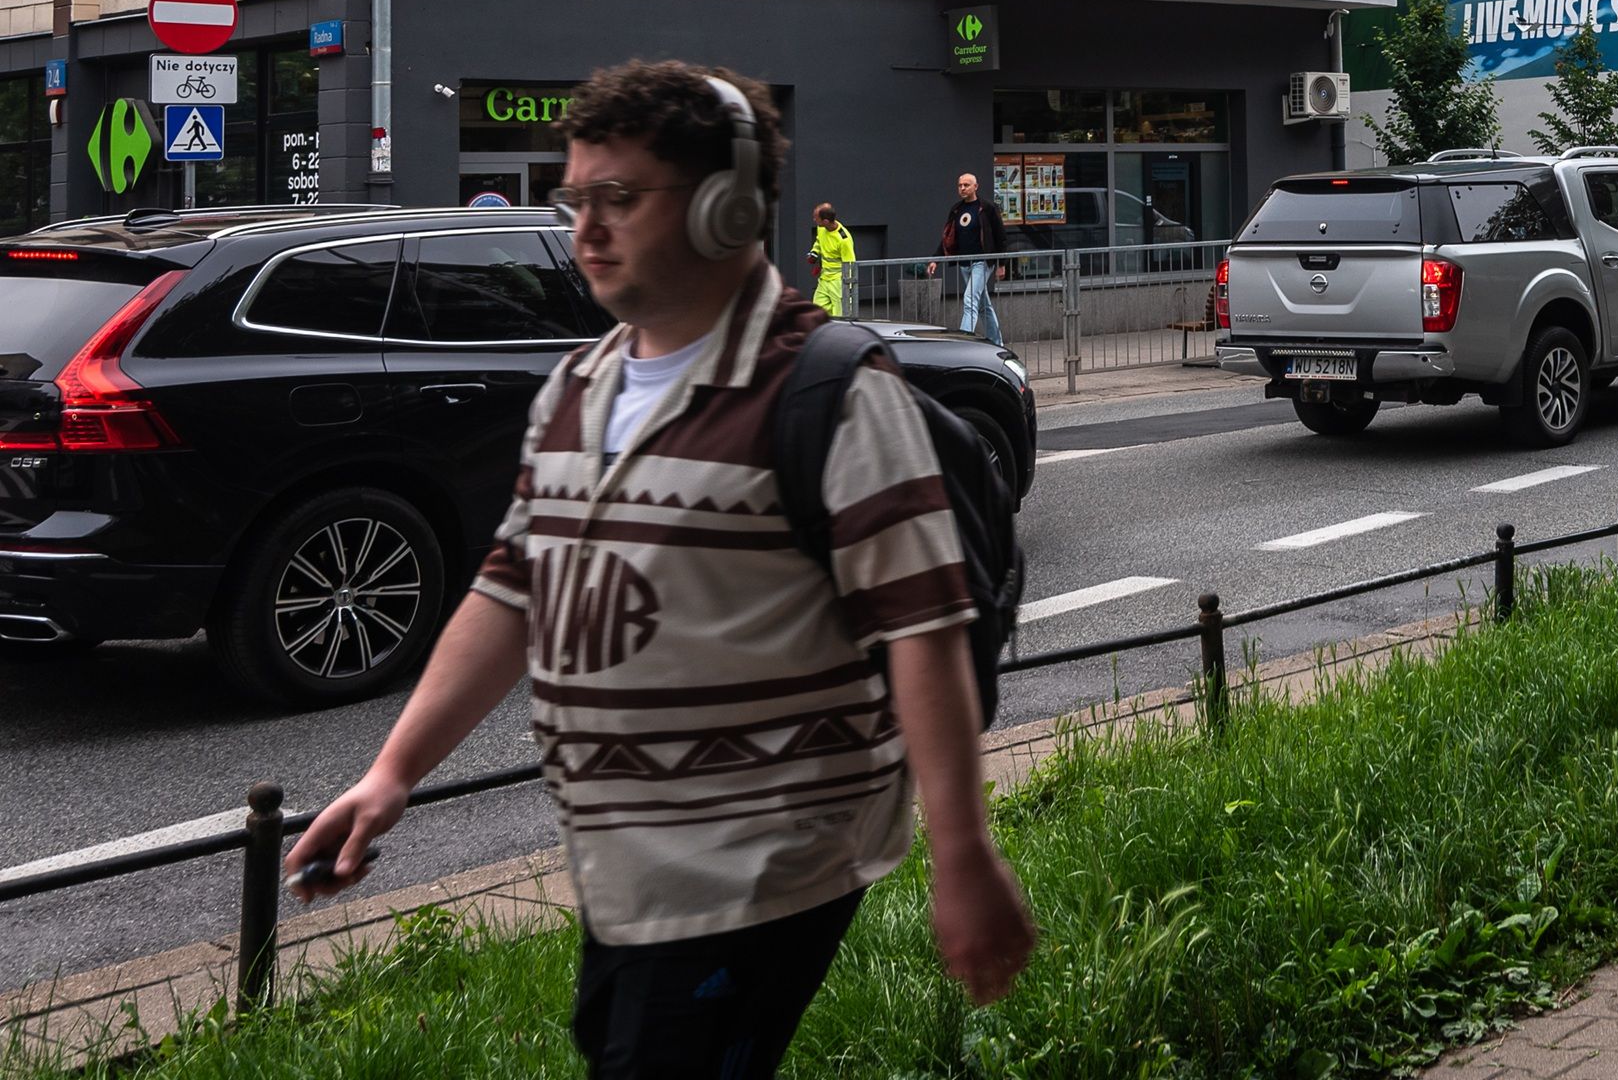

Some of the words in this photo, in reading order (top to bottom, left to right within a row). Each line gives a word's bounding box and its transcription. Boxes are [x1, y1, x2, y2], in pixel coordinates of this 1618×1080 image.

[953, 44, 987, 56] Carrefour
[156, 60, 180, 71] Nie
[185, 60, 235, 74] dotyczy
[1234, 313, 1272, 324] NAVARA
[1295, 358, 1311, 374] WU
[1315, 358, 1355, 375] 5218N
